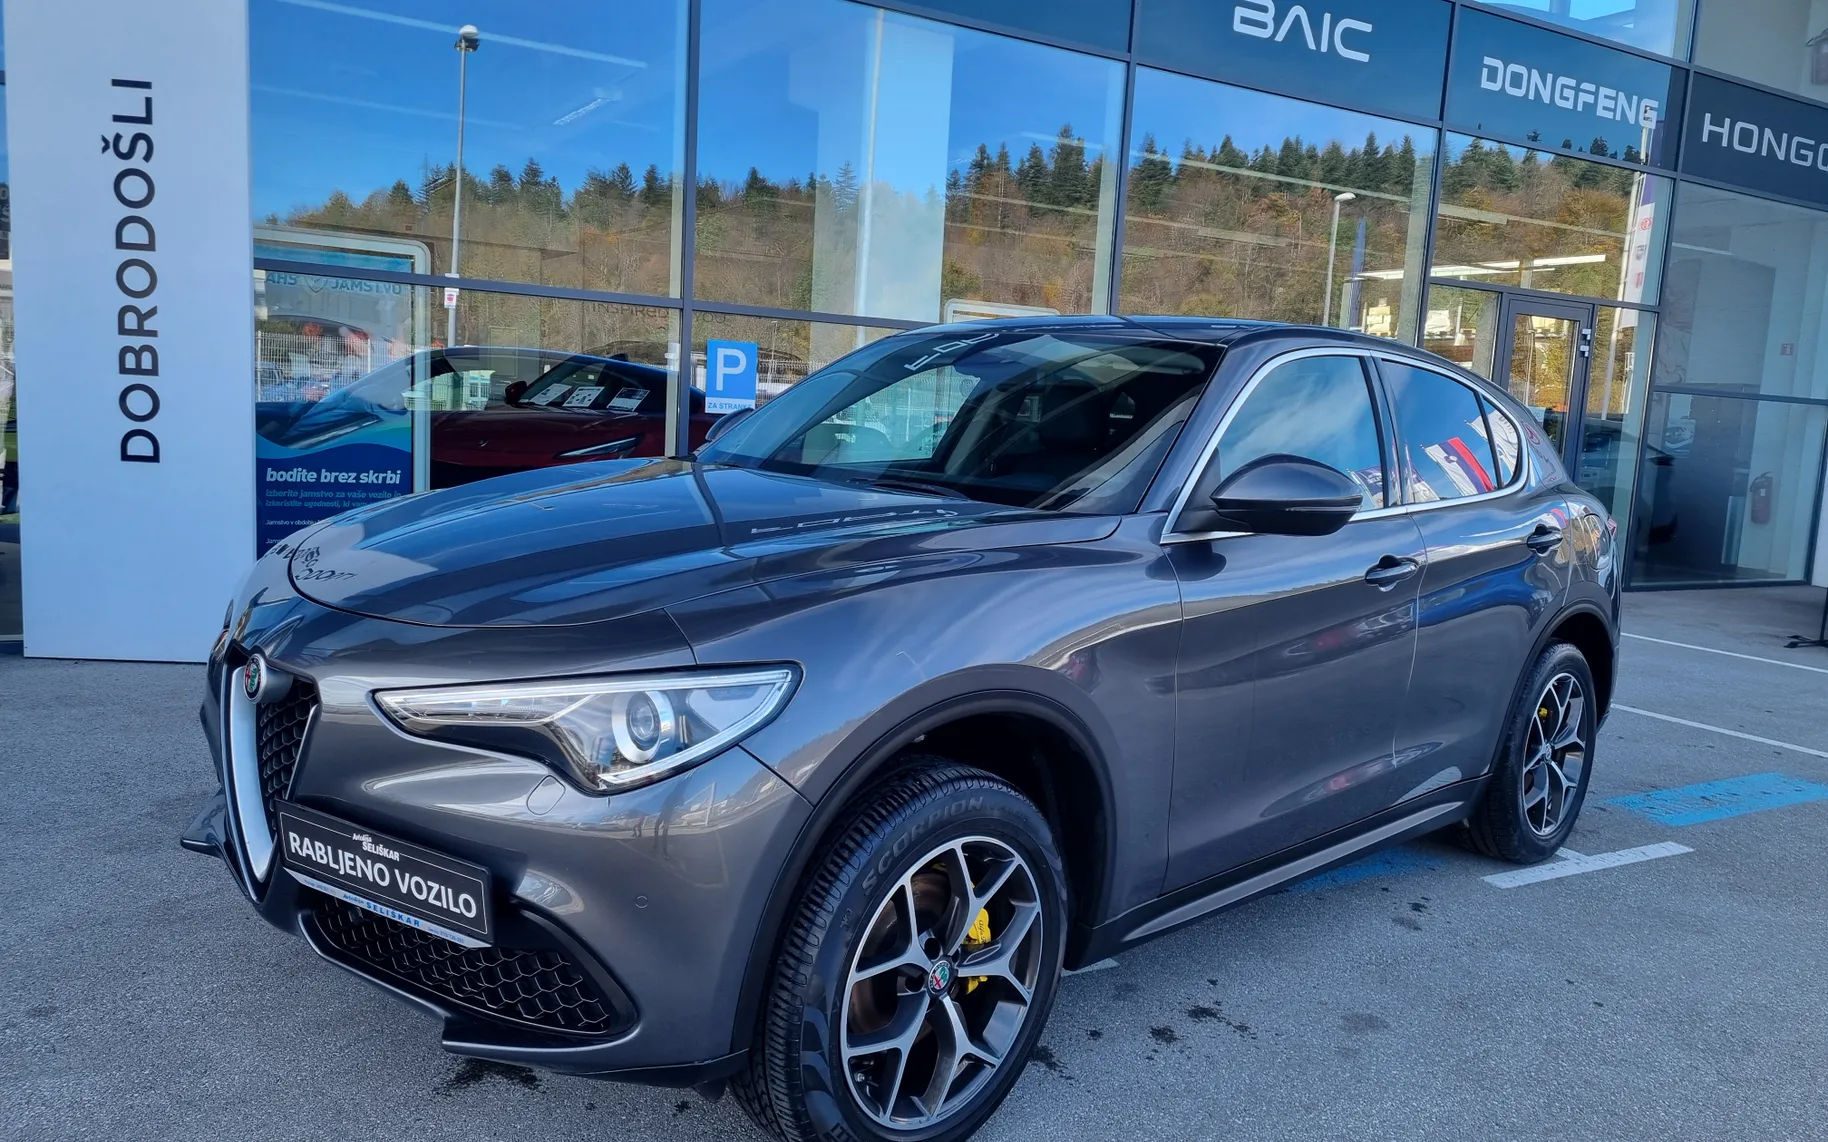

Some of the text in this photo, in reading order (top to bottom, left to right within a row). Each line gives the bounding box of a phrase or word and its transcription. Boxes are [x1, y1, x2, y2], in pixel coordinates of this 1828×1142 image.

[1233, 0, 1372, 62] BAIC
[1480, 56, 1659, 130] DONGFENG
[101, 78, 160, 463] DOBRODOŠLI
[716, 347, 747, 391] P
[265, 489, 299, 497] izberite
[299, 489, 334, 498] jamstvo
[347, 490, 366, 498] vaše
[368, 490, 392, 499] vozilo
[266, 468, 401, 484] bodite brez skrbi
[288, 831, 477, 919] RABLJENO VOZILO
[362, 841, 400, 862] SELIŠKAR
